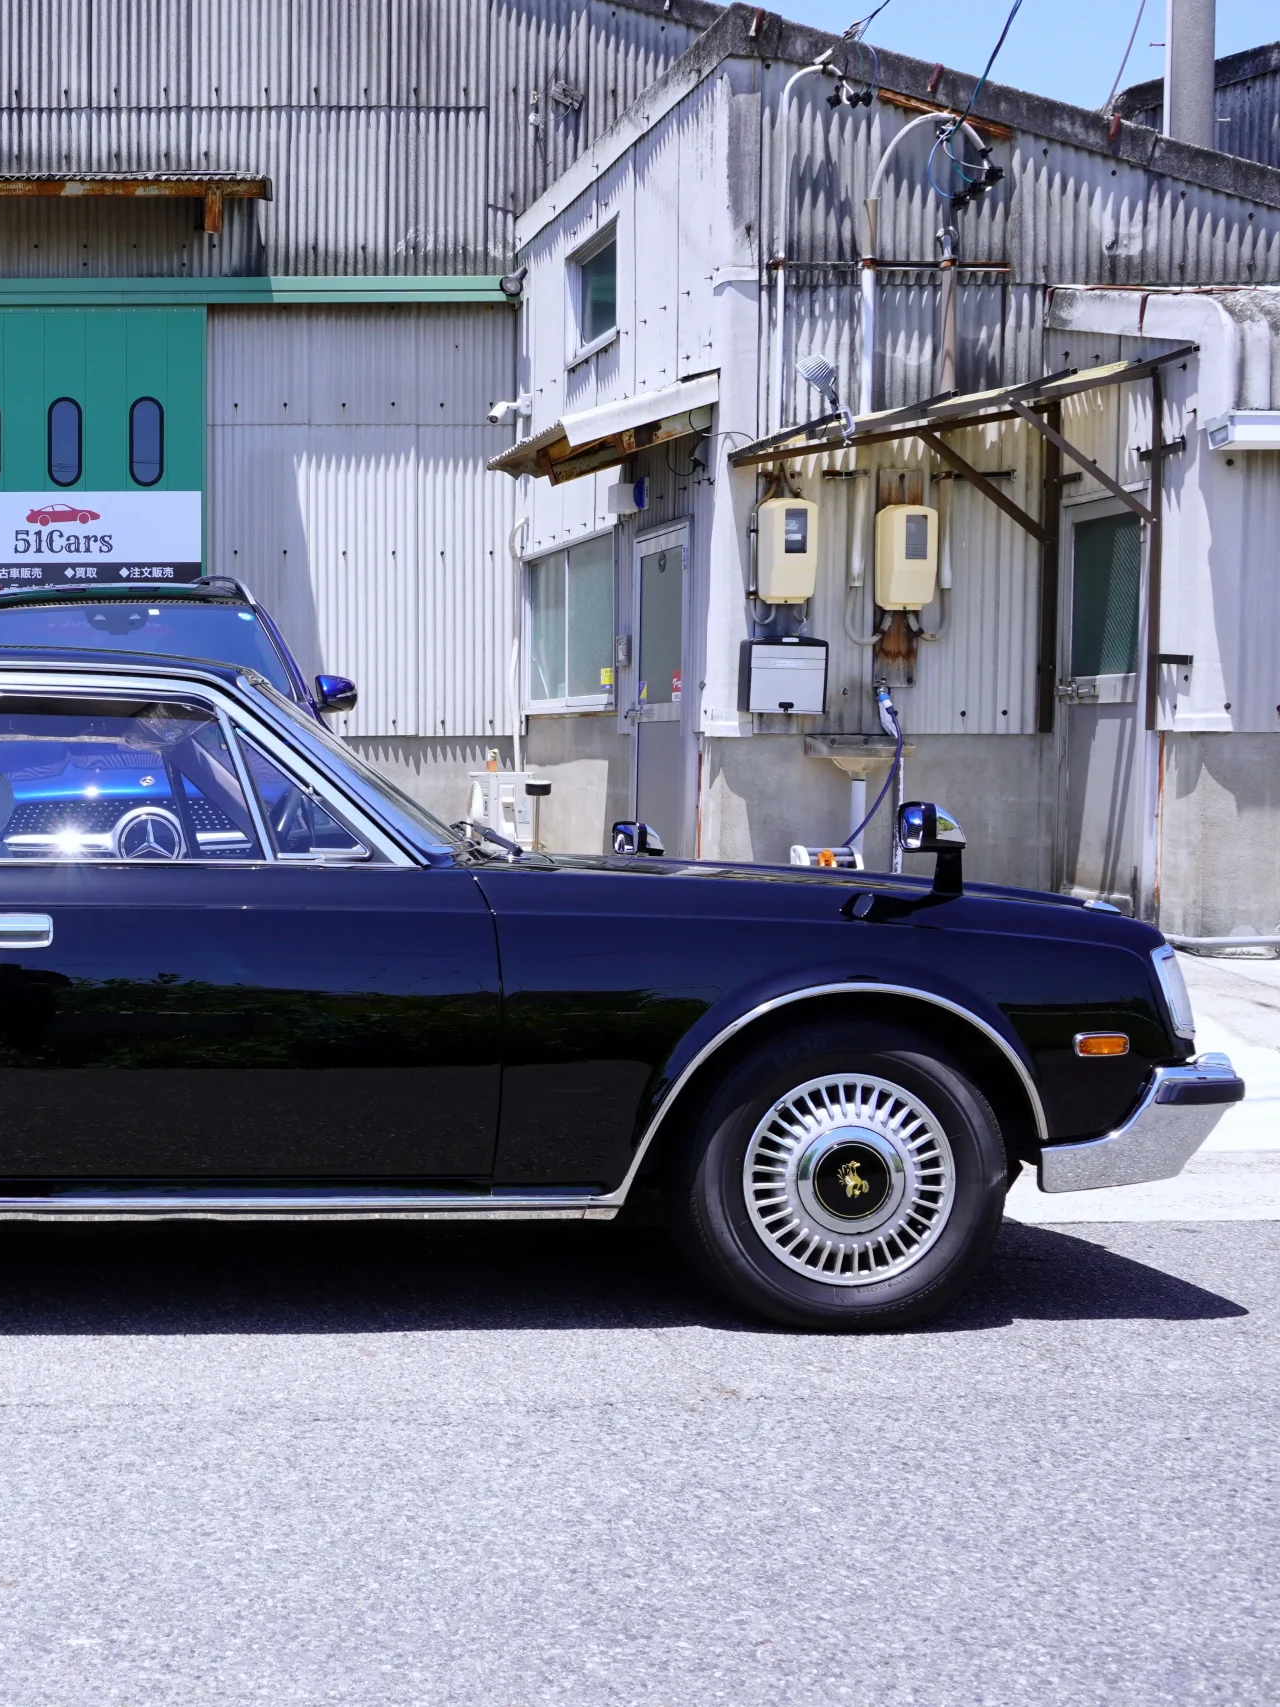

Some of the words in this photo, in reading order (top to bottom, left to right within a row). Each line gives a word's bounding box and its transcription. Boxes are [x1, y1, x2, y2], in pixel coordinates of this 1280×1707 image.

[13, 529, 114, 554] 51Cars
[75, 566, 97, 579] 買取
[129, 566, 174, 579] 注文販売
